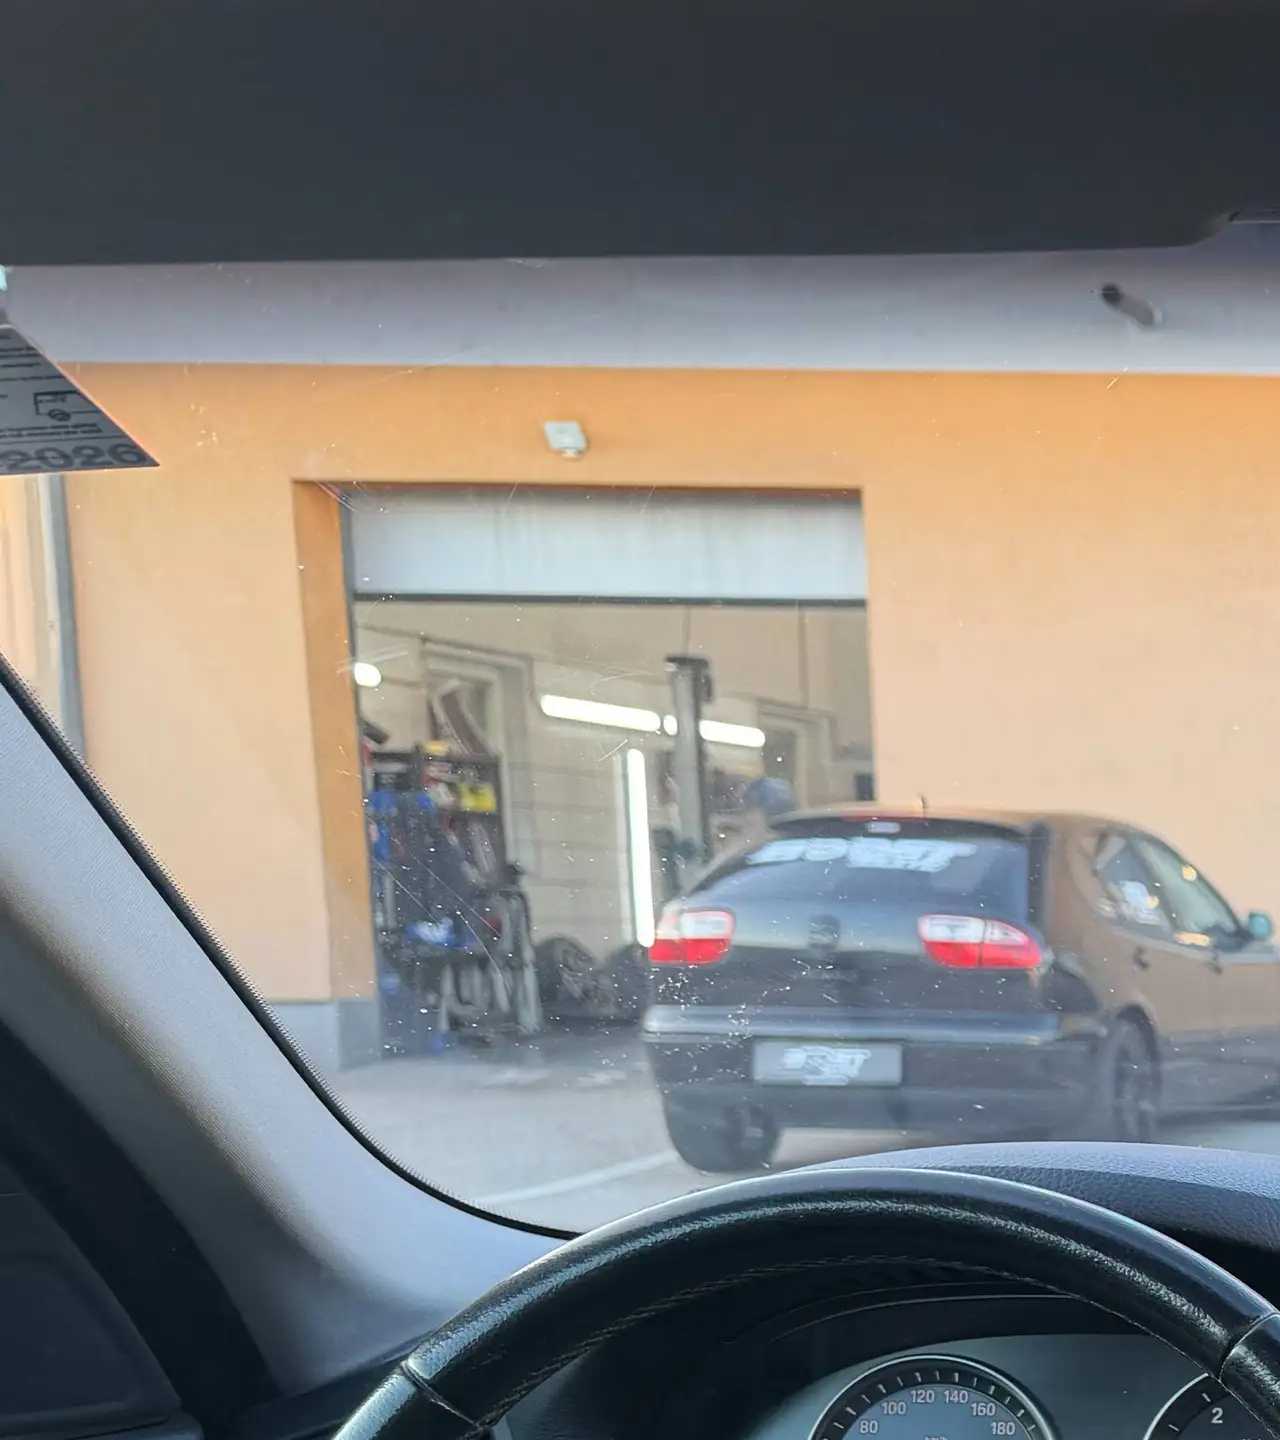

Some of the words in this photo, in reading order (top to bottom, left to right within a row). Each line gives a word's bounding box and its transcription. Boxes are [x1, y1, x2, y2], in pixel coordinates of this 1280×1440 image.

[910, 1390, 935, 1403] 120
[944, 1390, 969, 1404] 140
[881, 1401, 907, 1415] 100
[971, 1402, 996, 1416] 160
[1211, 1407, 1223, 1424] 2
[860, 1420, 878, 1434] 80
[991, 1422, 1016, 1436] 180
